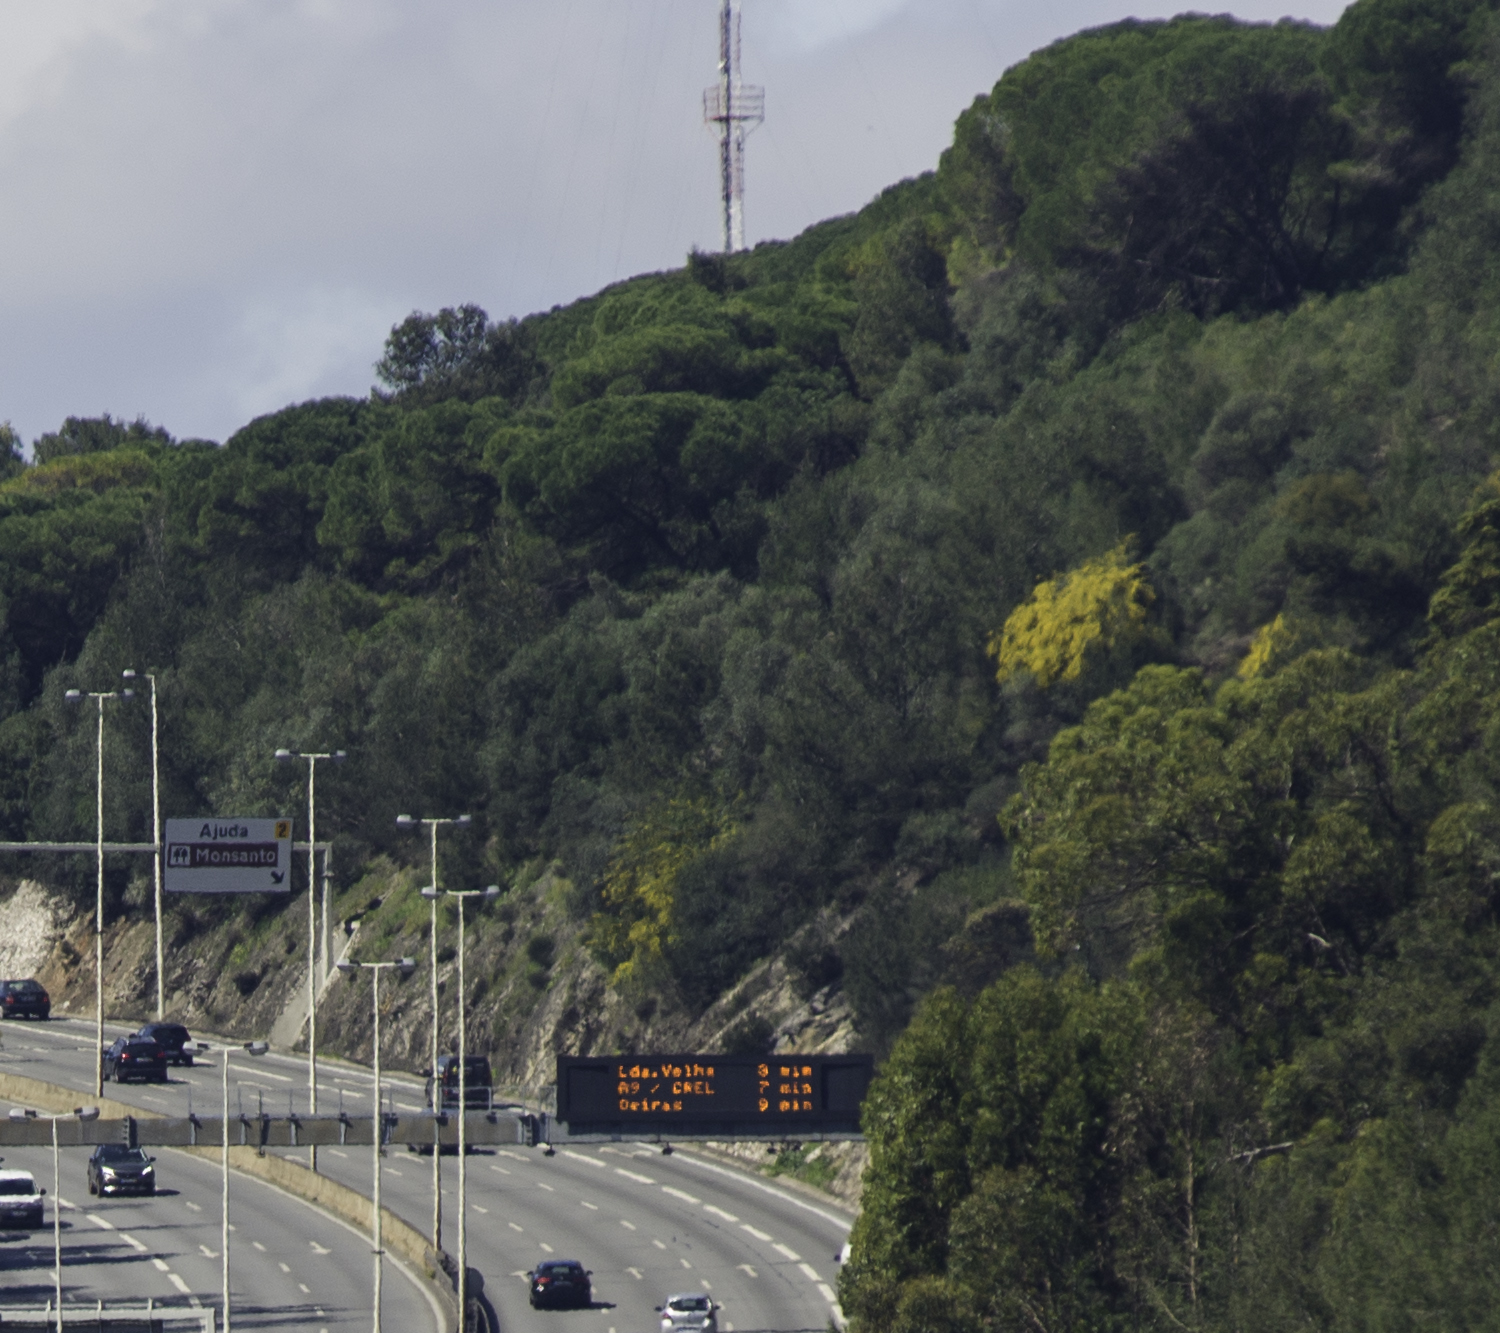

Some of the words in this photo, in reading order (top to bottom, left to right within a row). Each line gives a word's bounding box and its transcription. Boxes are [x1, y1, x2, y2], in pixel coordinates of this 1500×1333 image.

[200, 823, 248, 840] Ajuda
[278, 822, 287, 838] 2
[196, 848, 276, 862] Monsanto
[618, 1081, 640, 1094] A9
[672, 1081, 715, 1094] CREL
[759, 1081, 770, 1094] 7
[780, 1082, 812, 1094] min
[758, 1098, 769, 1112] 9
[779, 1099, 812, 1112] min
